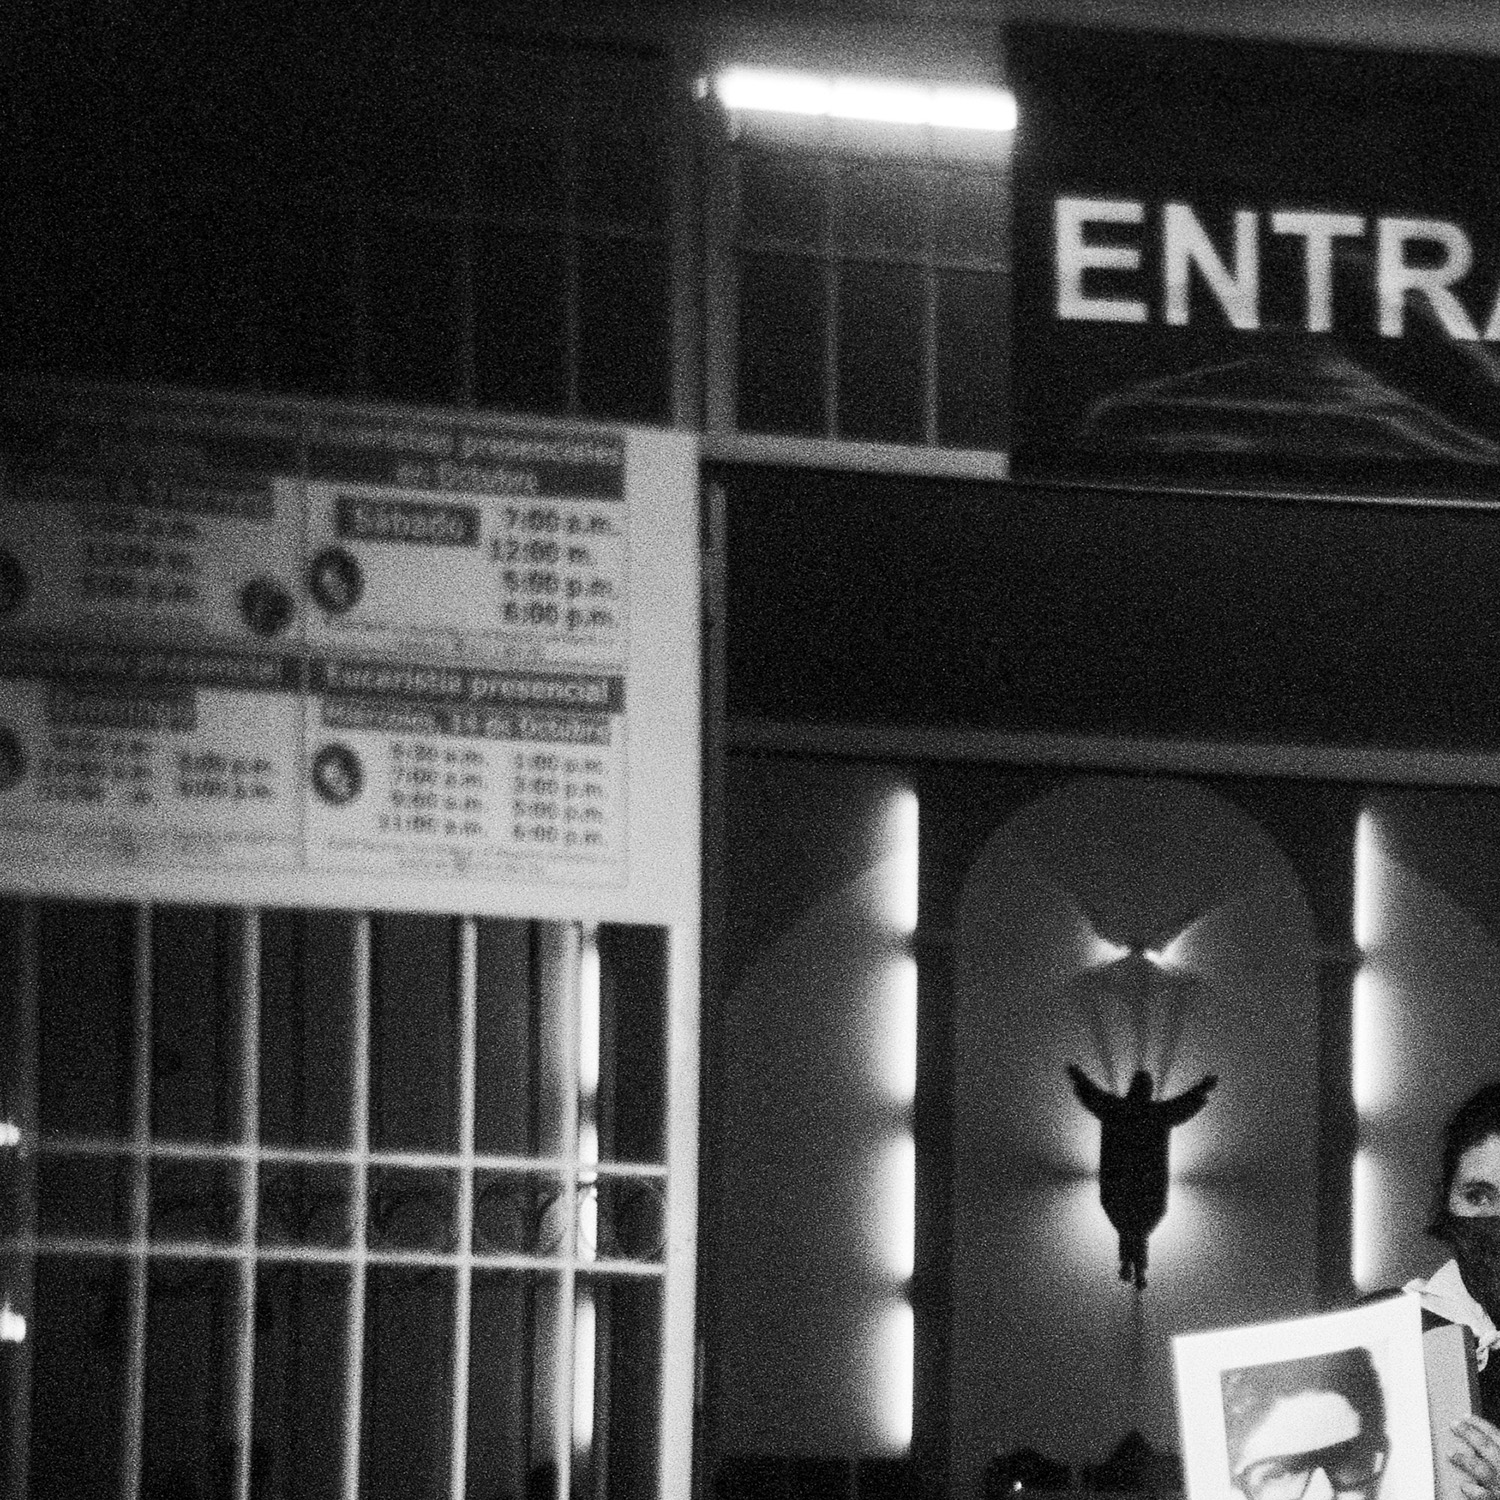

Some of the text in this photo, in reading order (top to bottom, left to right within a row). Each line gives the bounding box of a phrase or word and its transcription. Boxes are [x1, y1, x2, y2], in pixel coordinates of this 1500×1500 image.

[505, 506, 560, 533] 7:00
[490, 539, 560, 565] 12:00
[471, 675, 609, 705] presencial
